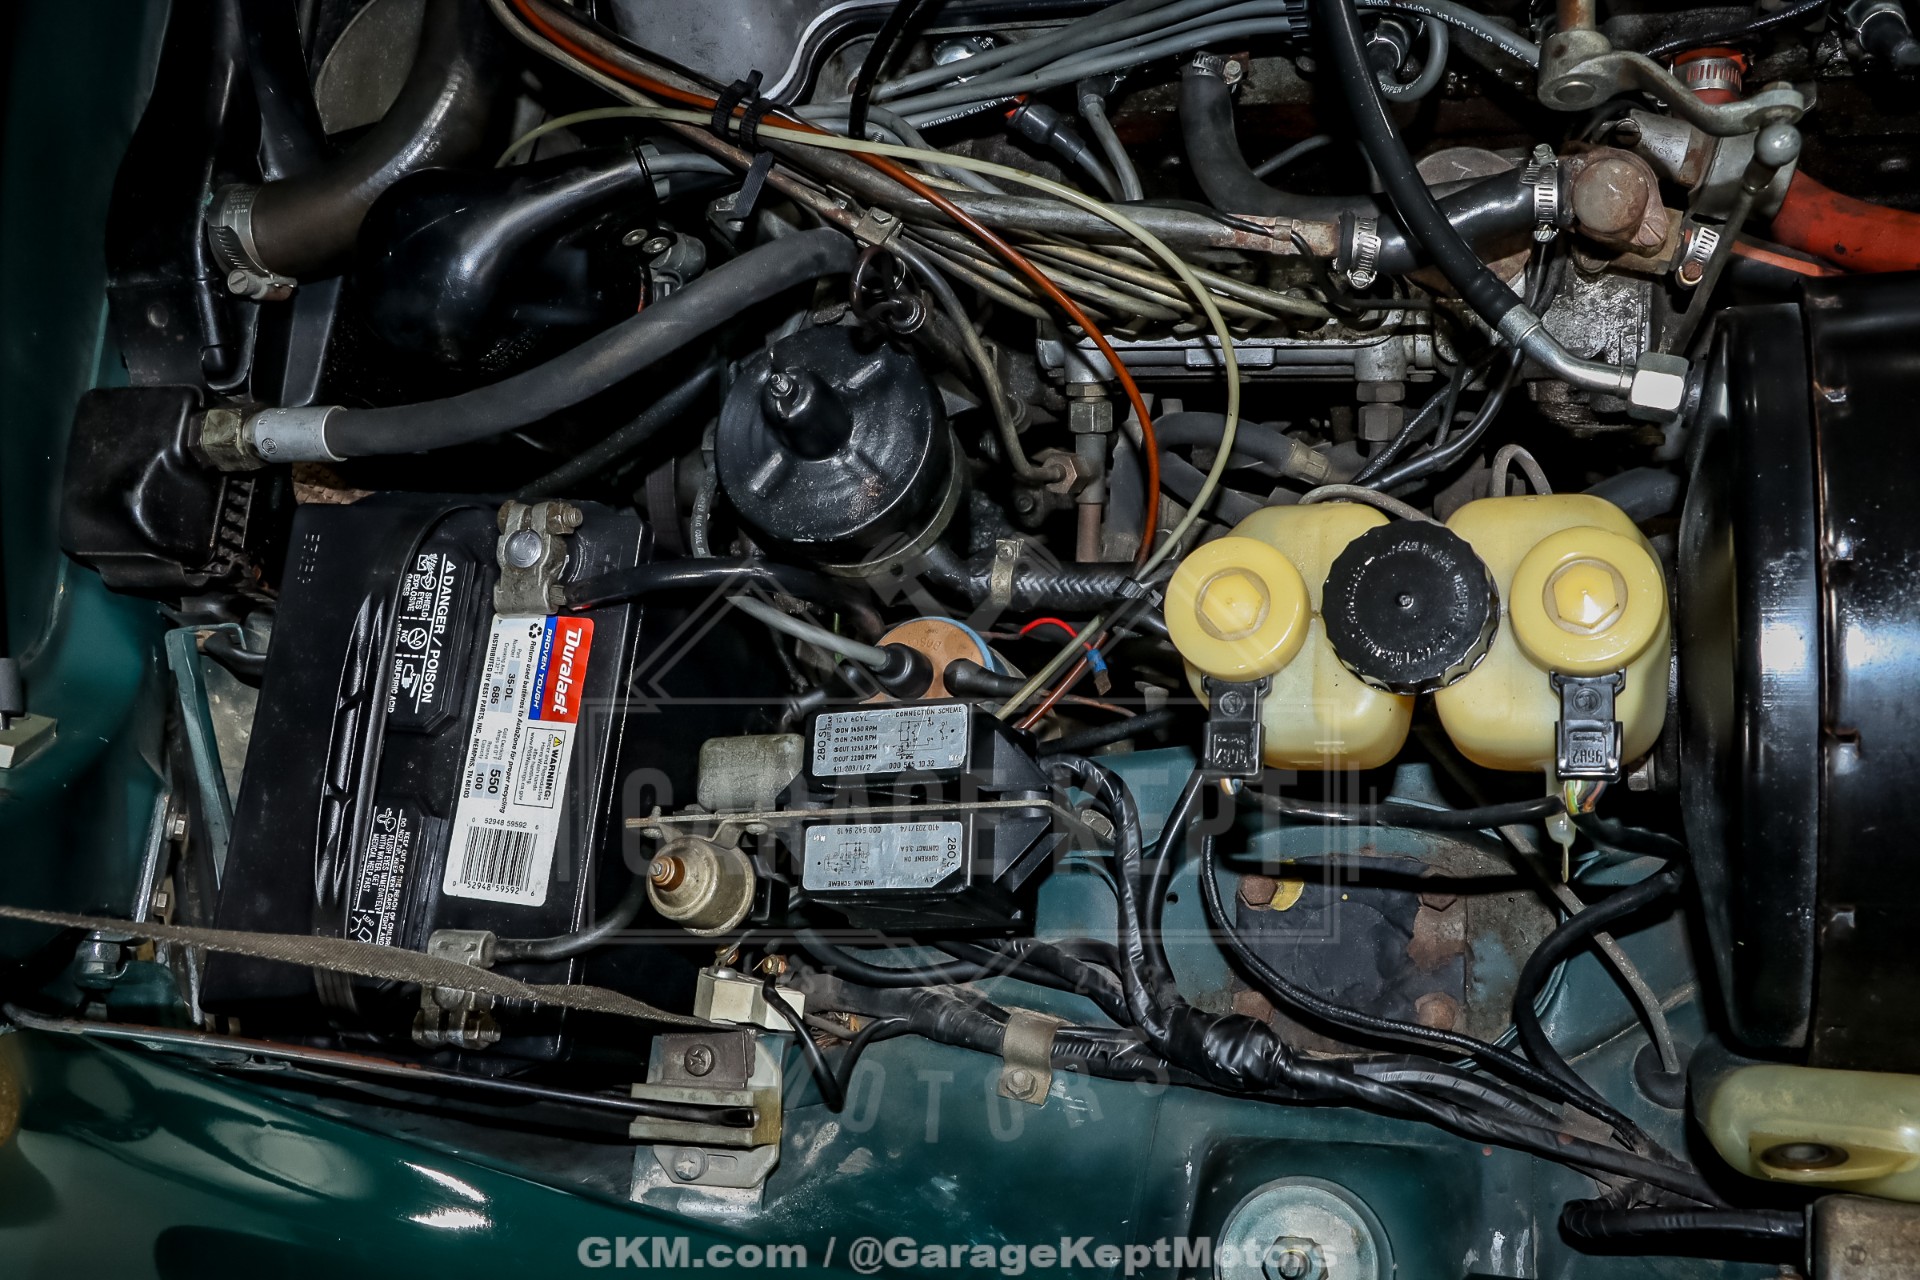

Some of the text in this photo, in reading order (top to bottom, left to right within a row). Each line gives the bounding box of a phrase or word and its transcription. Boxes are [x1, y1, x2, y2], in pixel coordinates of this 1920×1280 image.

[1436, 10, 1493, 43] OPTI-LAYER
[1498, 42, 1524, 62] 7MM
[920, 100, 998, 129] ULTRA-PREMIUM
[403, 574, 412, 595] GASES
[407, 574, 420, 611] EXPLOSIVE
[415, 592, 424, 609] EYES
[422, 592, 432, 617] SHIELD
[434, 576, 453, 634] DANGER
[400, 630, 408, 642] NO
[487, 634, 499, 672] DISTRIBUTED
[421, 650, 440, 702] POISON
[534, 629, 552, 708] PROVEN TOUGH
[553, 628, 582, 714] Duralast
[388, 659, 402, 712] SULFURIC ACID
[491, 686, 500, 704] 685
[505, 674, 515, 700] 35-DL
[520, 681, 529, 708] batteries
[477, 700, 486, 721] PARTS,
[895, 706, 962, 718] CONNECTION SCHEME
[512, 718, 522, 749] AutoZone
[816, 725, 828, 761] 280 SL
[468, 738, 479, 768] MEMPHIS,
[865, 753, 877, 761] RPM
[467, 770, 473, 778] TN
[544, 750, 558, 800] WARNING:
[889, 762, 901, 770] 000
[919, 760, 926, 768] 10
[475, 772, 484, 790] 100
[488, 769, 500, 794] 550
[499, 784, 509, 813] recycling
[399, 817, 406, 827] DO
[869, 826, 882, 834] 000
[379, 834, 387, 849] WITH
[396, 830, 404, 841] NOT
[915, 854, 939, 862] CURRENT
[947, 836, 957, 859] 280
[363, 834, 379, 892] MEDICAL HELP FAST
[375, 835, 394, 911] FLUSH EYES IMMEDIATELY
[399, 865, 404, 873] OF
[467, 881, 491, 891] 52948
[495, 885, 520, 895] 59592
[828, 880, 851, 888] SCHEME
[384, 894, 393, 909] CAPS
[392, 890, 400, 910] REACH
[363, 914, 374, 926] LEAD
[380, 912, 390, 930] TIGHT
[390, 912, 395, 920] OF
[385, 923, 394, 947] CHILDR
